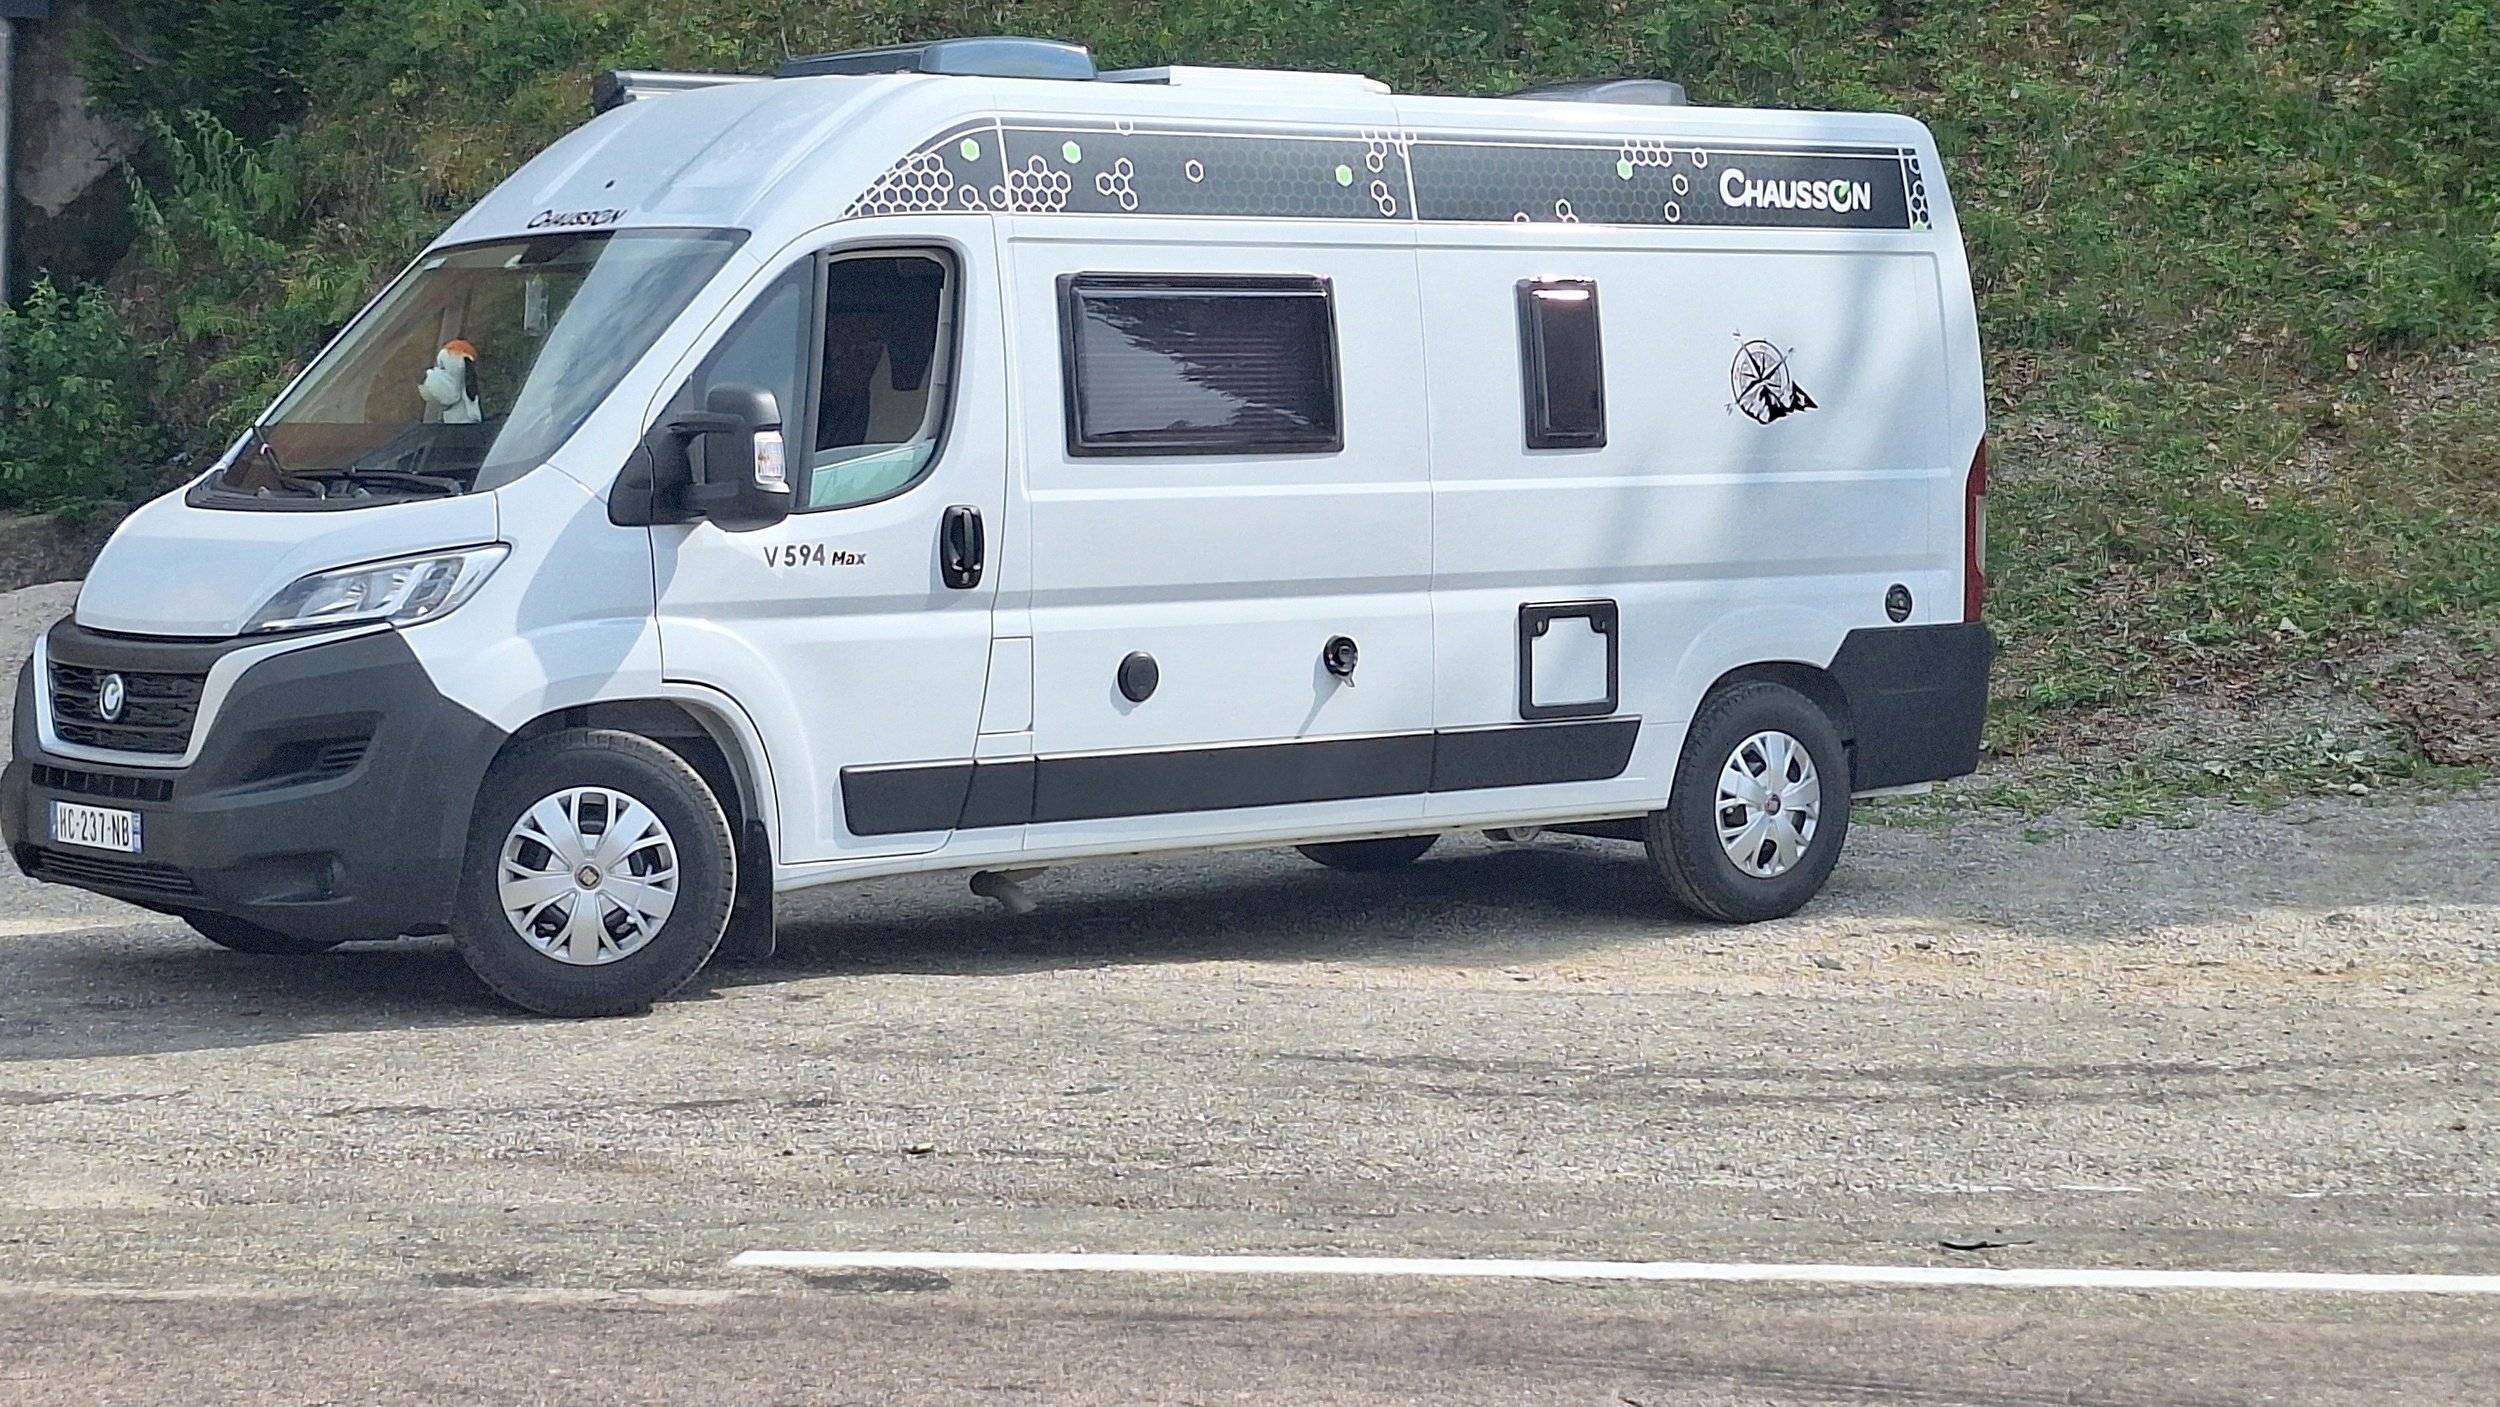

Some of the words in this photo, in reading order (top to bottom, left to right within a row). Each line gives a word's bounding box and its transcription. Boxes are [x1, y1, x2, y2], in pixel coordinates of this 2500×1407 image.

[1719, 168, 1871, 213] CHAUSSON
[763, 545, 779, 568] V
[784, 543, 826, 567] 594
[831, 551, 867, 566] Max
[59, 807, 130, 847] HC-237-NB
